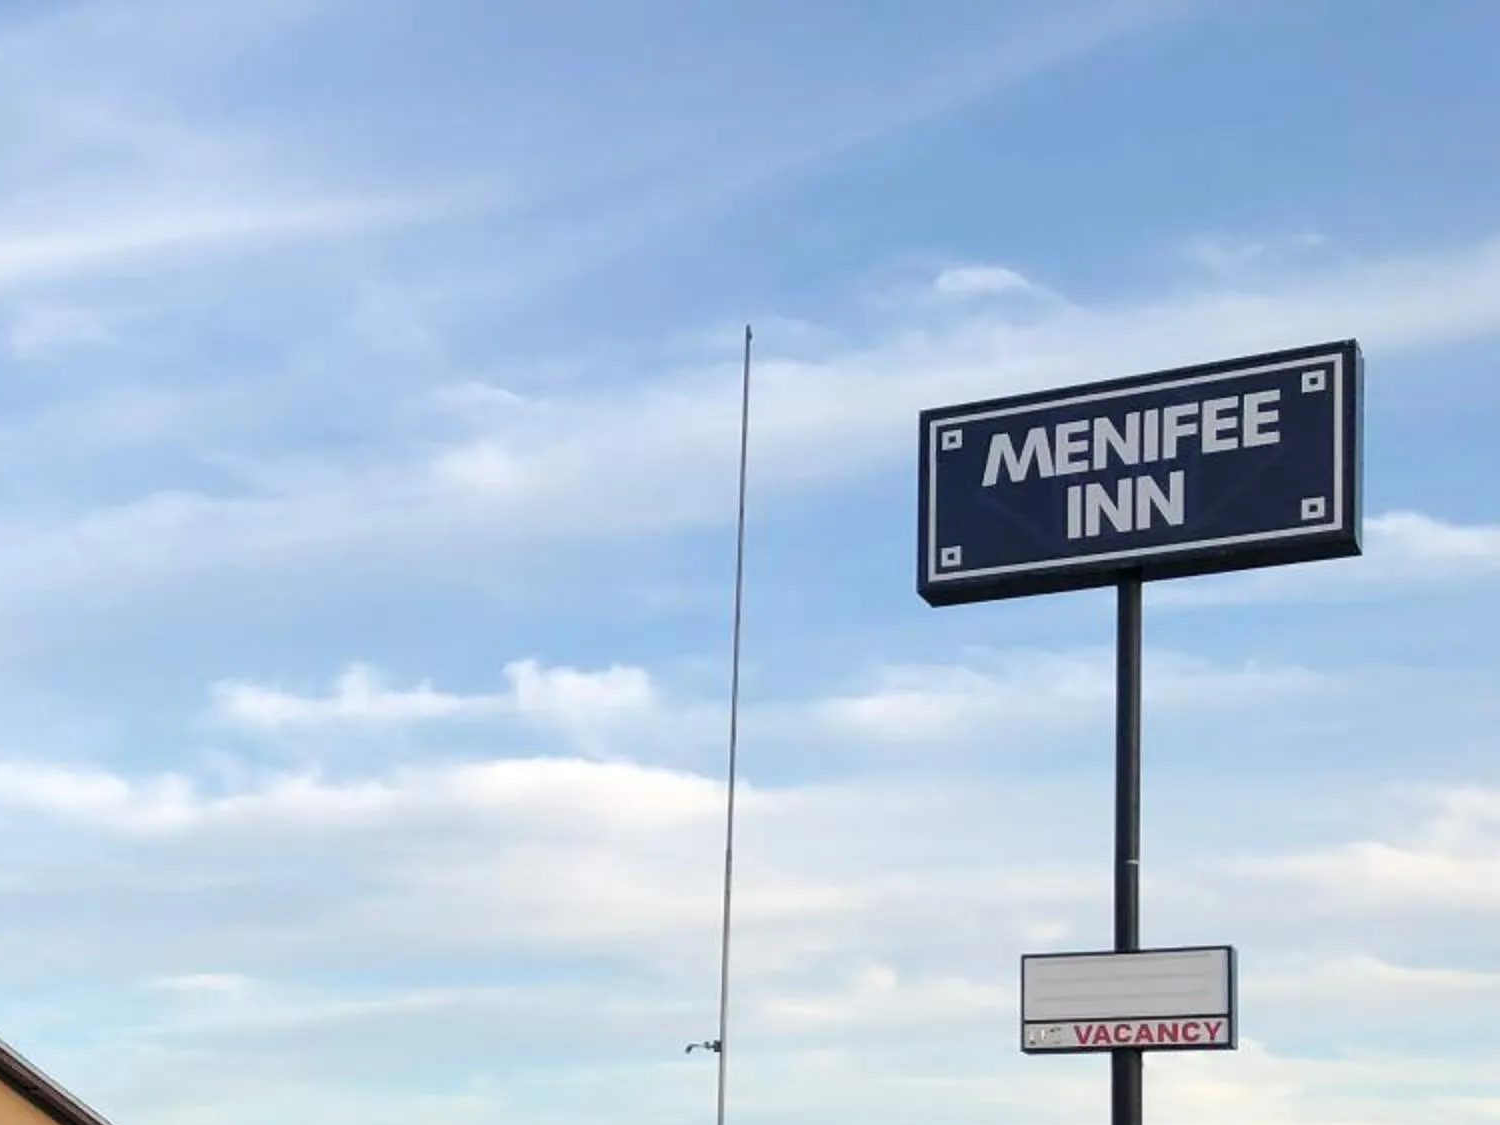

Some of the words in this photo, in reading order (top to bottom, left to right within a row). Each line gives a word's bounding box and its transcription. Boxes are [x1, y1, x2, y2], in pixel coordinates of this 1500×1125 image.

[982, 389, 1281, 487] MENIFEE
[1067, 470, 1185, 539] INN
[1074, 1021, 1222, 1045] VACANCY
